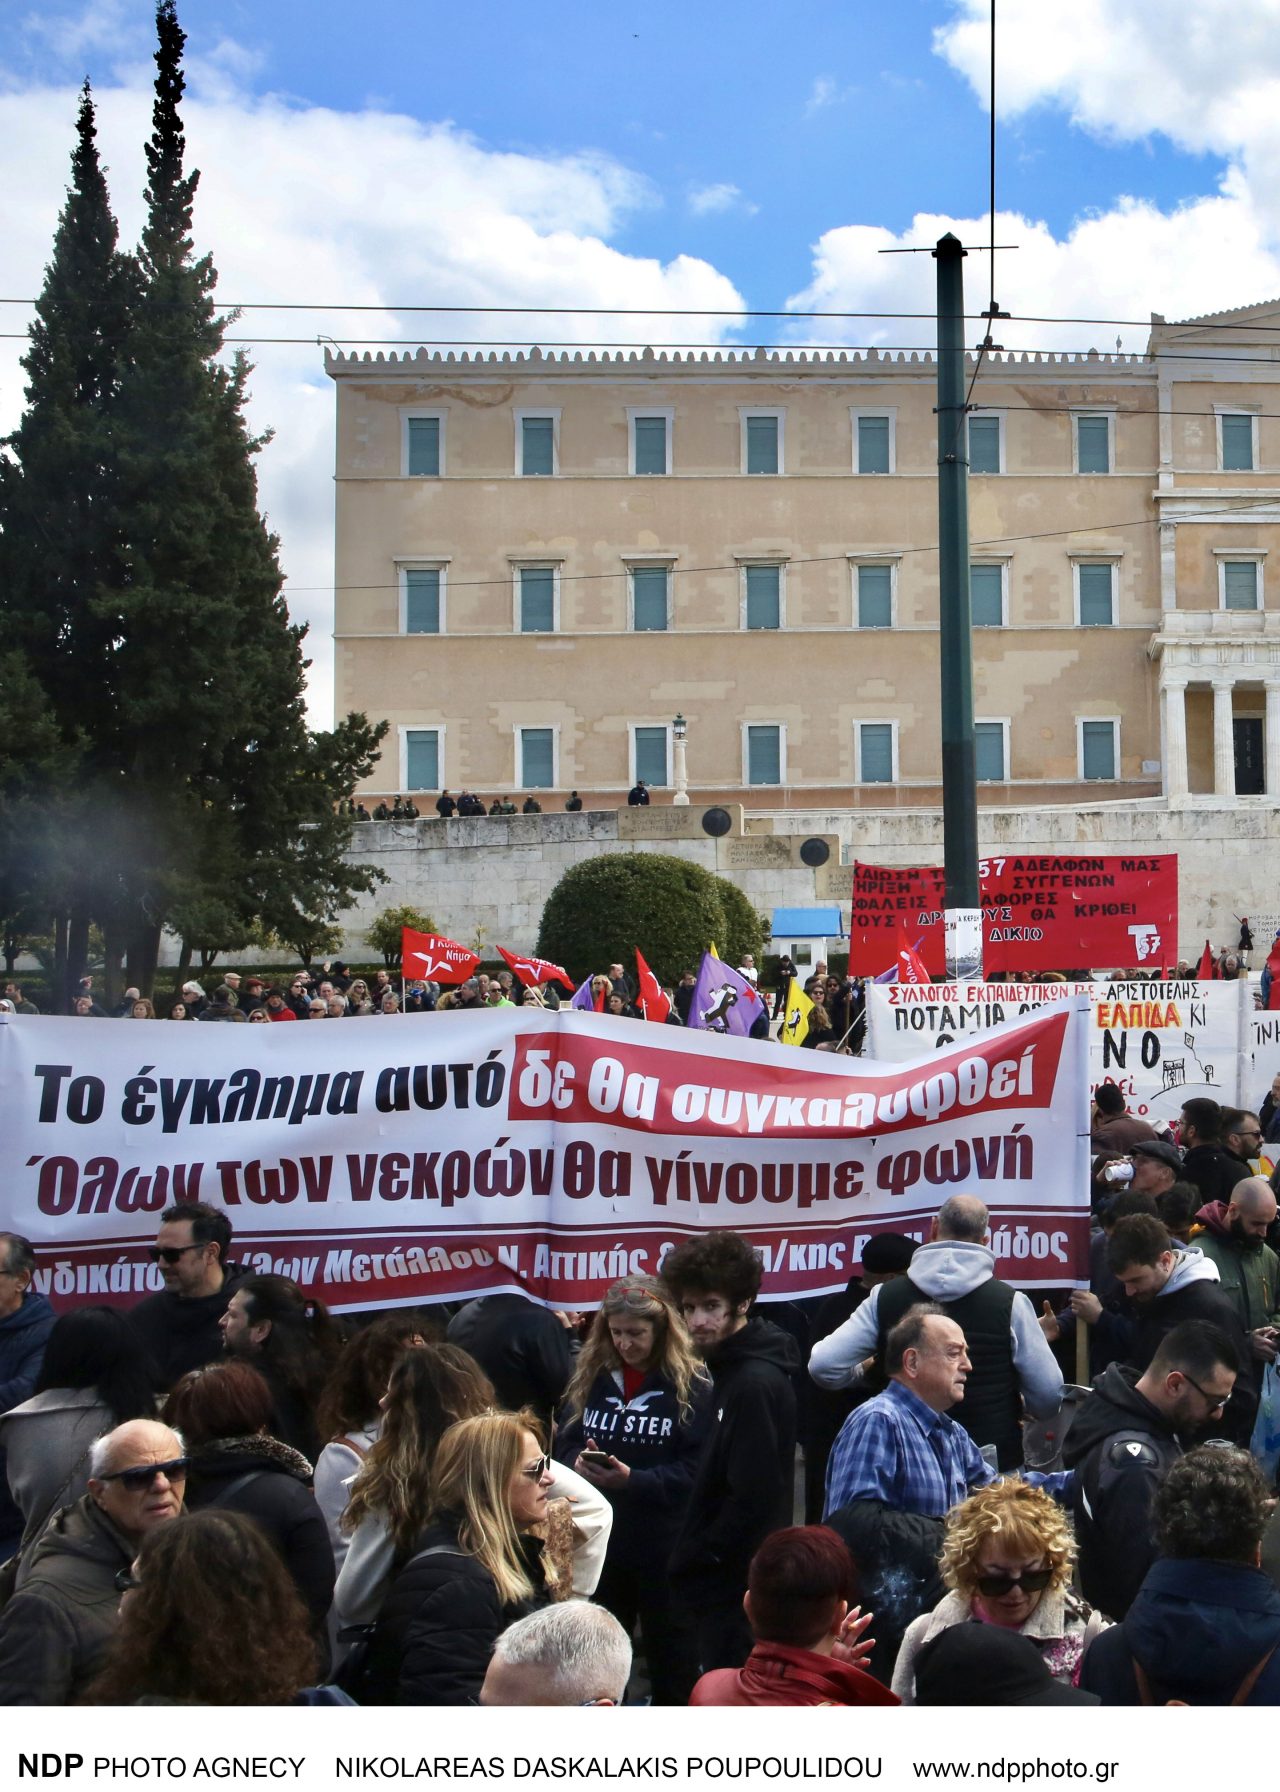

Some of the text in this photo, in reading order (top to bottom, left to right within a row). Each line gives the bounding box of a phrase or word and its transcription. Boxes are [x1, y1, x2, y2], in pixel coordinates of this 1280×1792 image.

[1012, 859, 1104, 872] ΑΔΕΛΦΩΝ
[1121, 859, 1160, 872] ΜΑΣ
[854, 881, 910, 894] ΗΡΙΞΗ
[1013, 875, 1115, 889] ΣΥΓΓΕΝΩΝ
[1030, 908, 1056, 920] ΘΑ
[1073, 903, 1137, 918] ΚΡΙΘΕΙ
[989, 926, 1043, 942] ΔΙΚΙΟ
[446, 949, 471, 963] Νήμα
[888, 985, 959, 1004] ΣΥΛΛΟΓΟΣ
[967, 985, 1069, 1002] ΕΚΠΑΙΔΕΥΤΙΚΩΝ
[895, 1003, 1005, 1031] ΠΟΤΑΜΙΑ
[1097, 1002, 1182, 1029] ΕΛΠΙΔΑ
[1190, 1003, 1206, 1028] ΚΙ
[34, 1065, 106, 1124] Το
[120, 1066, 365, 1133] έγκλημα
[375, 1050, 507, 1113] αυτό
[519, 1050, 574, 1109] δε
[587, 1057, 660, 1121] θα
[671, 1044, 1038, 1133] συγκαλυφθεί
[25, 1123, 1033, 1216] Όλων των νεκρών θα γίνουμε φωνή
[323, 1246, 495, 1284] Μετάλλου
[498, 1245, 527, 1280] Ν.
[533, 1242, 649, 1281] Αττικής
